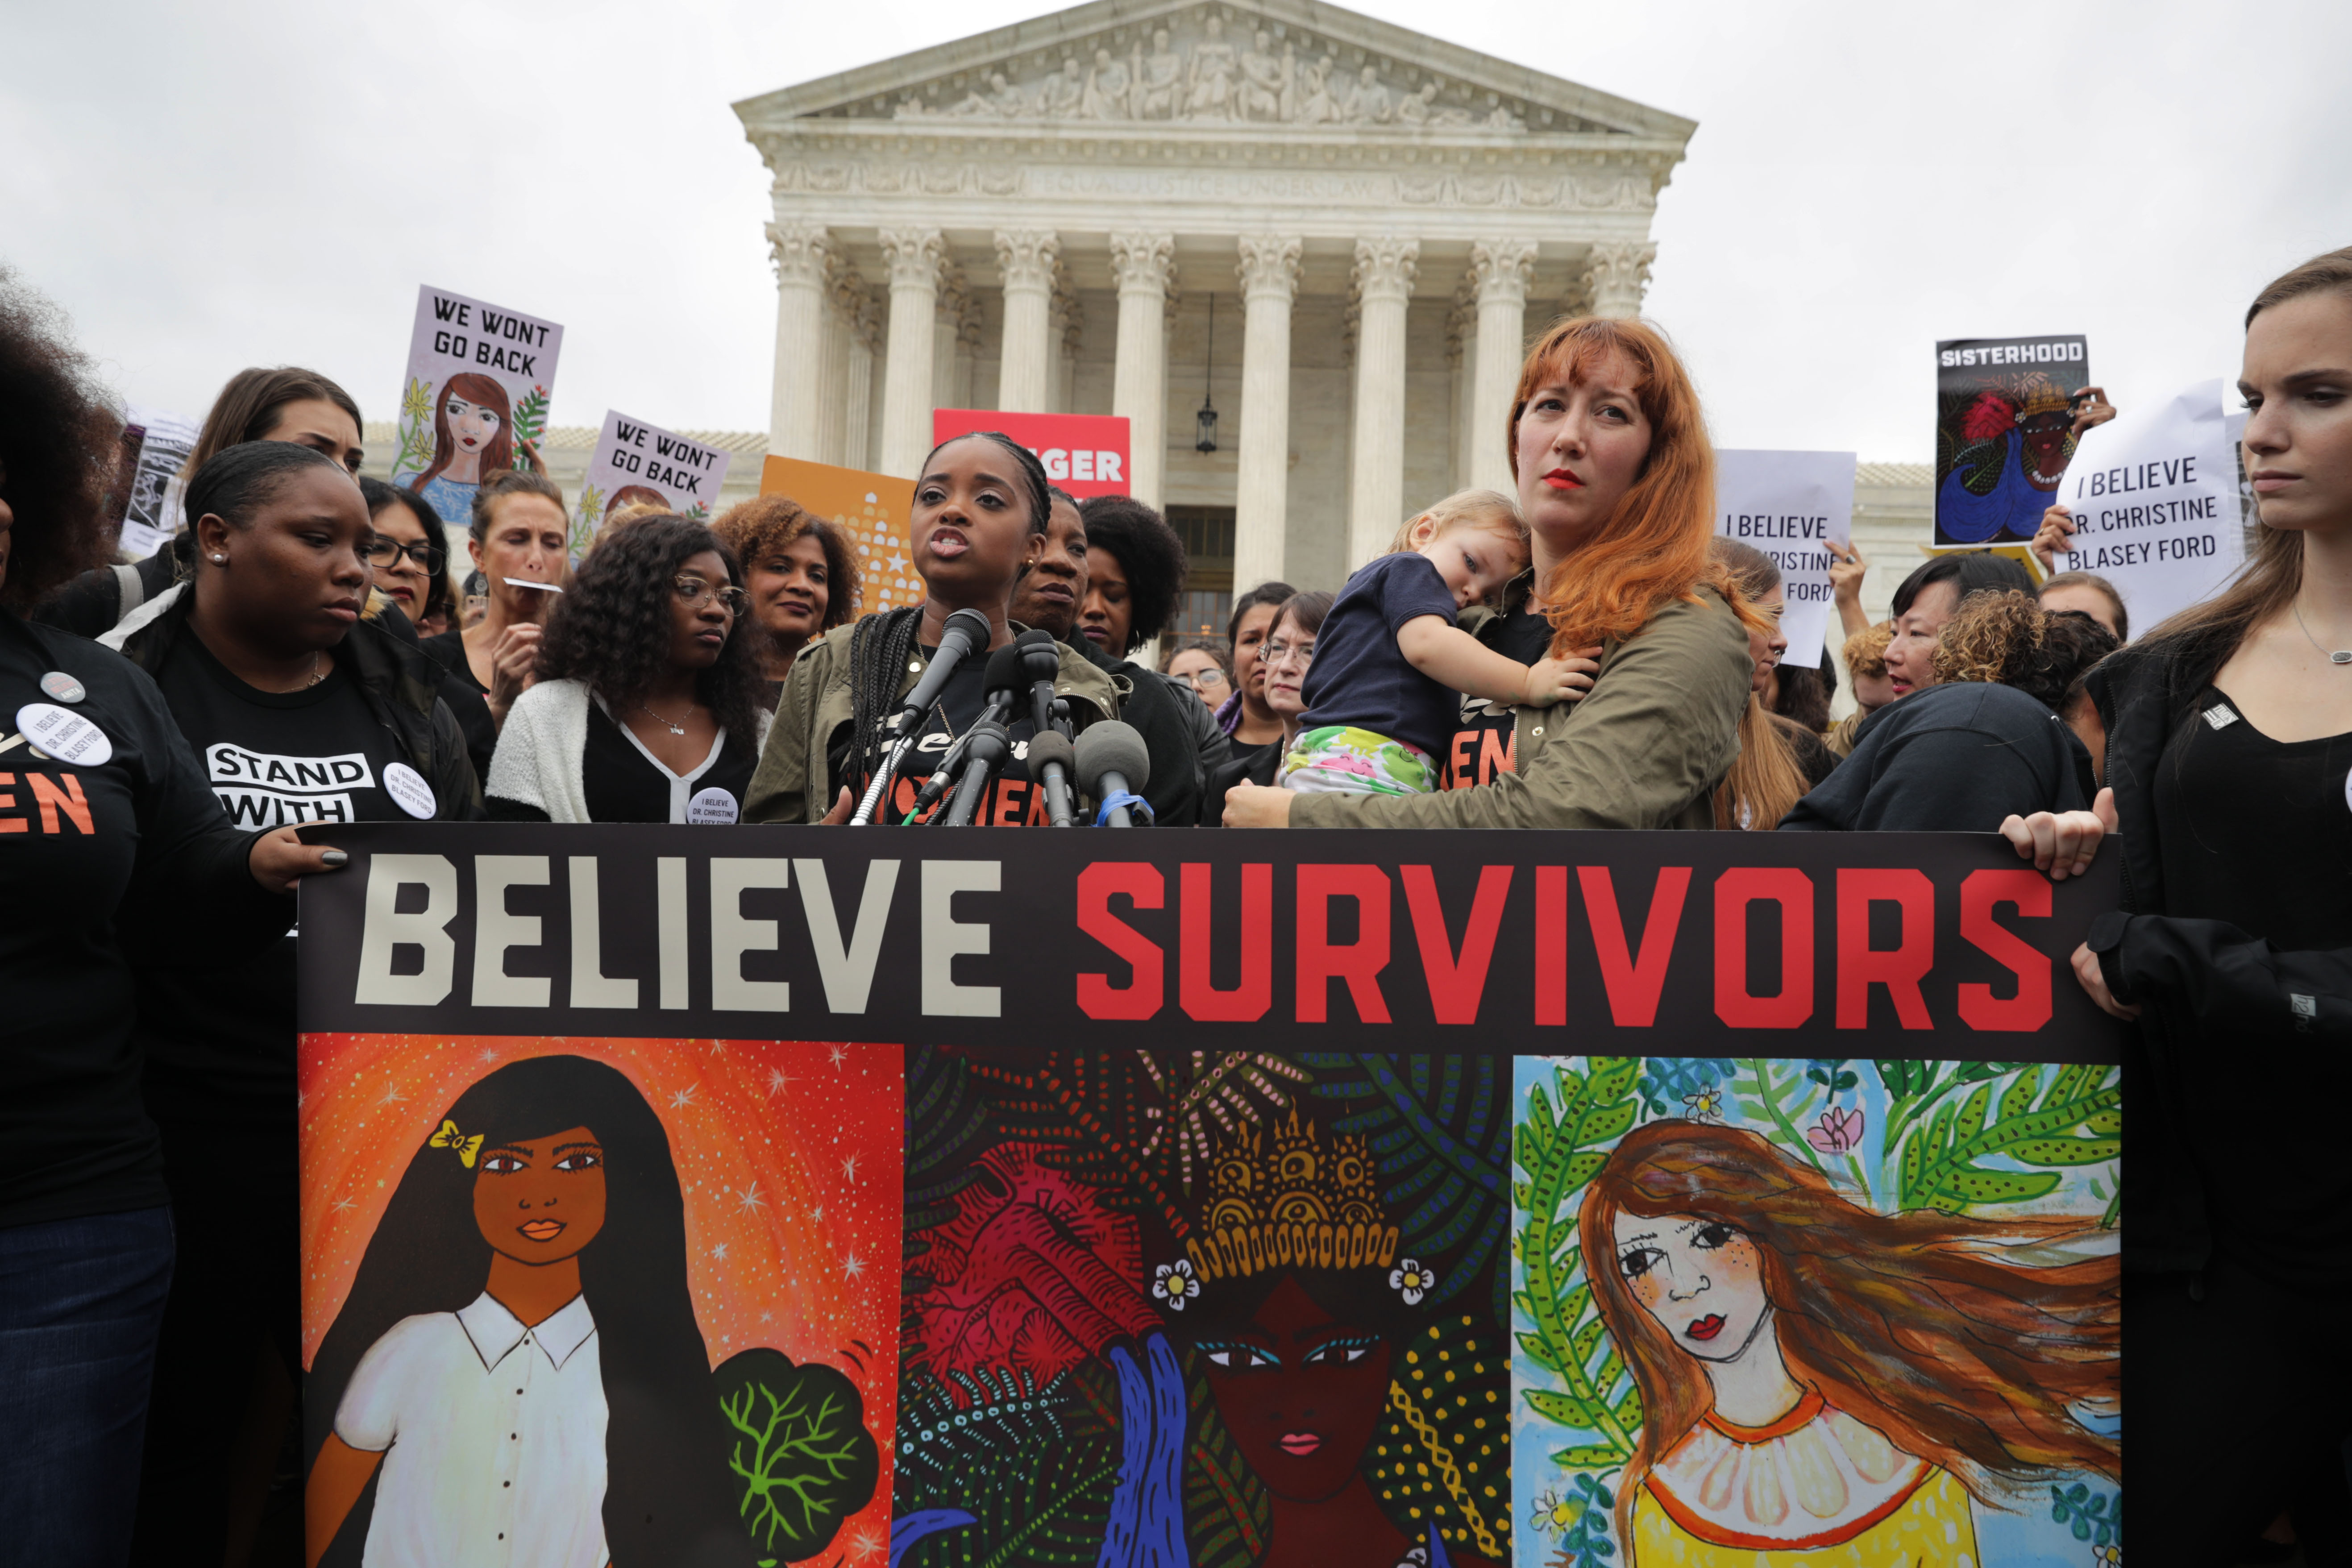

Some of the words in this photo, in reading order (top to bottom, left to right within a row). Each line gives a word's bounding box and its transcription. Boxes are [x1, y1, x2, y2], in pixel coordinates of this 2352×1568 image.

[434, 296, 471, 327] WE
[482, 309, 549, 348] WONT
[435, 330, 467, 359] GO
[476, 341, 537, 377] BACK
[1941, 342, 2083, 367] SISTERHOOD
[618, 420, 648, 448] WE
[657, 435, 718, 470] WONT
[611, 448, 641, 473] GO
[646, 460, 702, 494] BACK
[1027, 448, 1124, 482] GER
[2078, 477, 2084, 499] I
[2090, 456, 2197, 497] BELIEVE
[1726, 514, 1731, 536] I
[1739, 515, 1828, 539] BELIEVE
[2101, 497, 2217, 531] CHRISTINE
[2068, 542, 2151, 570] BLASEY
[2159, 535, 2215, 561] FORD
[61, 687, 82, 700] ANITA
[36, 711, 64, 730] BELIEVE
[45, 738, 63, 749] DR.
[55, 717, 87, 741] CHRISTINE
[64, 738, 91, 760] BLASEY
[83, 729, 103, 744] FORD
[215, 748, 364, 786] STAND
[402, 771, 425, 791] BELIEVE
[391, 774, 401, 785] DR.
[402, 781, 432, 805] CHRISTINE
[392, 784, 415, 803] BLASEY
[417, 800, 432, 814] FORD
[705, 798, 728, 807] BELIEVE
[220, 794, 345, 826] WITH
[704, 809, 735, 817] CHRISTINE
[355, 854, 1001, 1017] BELIEVE
[1076, 861, 2053, 1032] SURVIVORS
